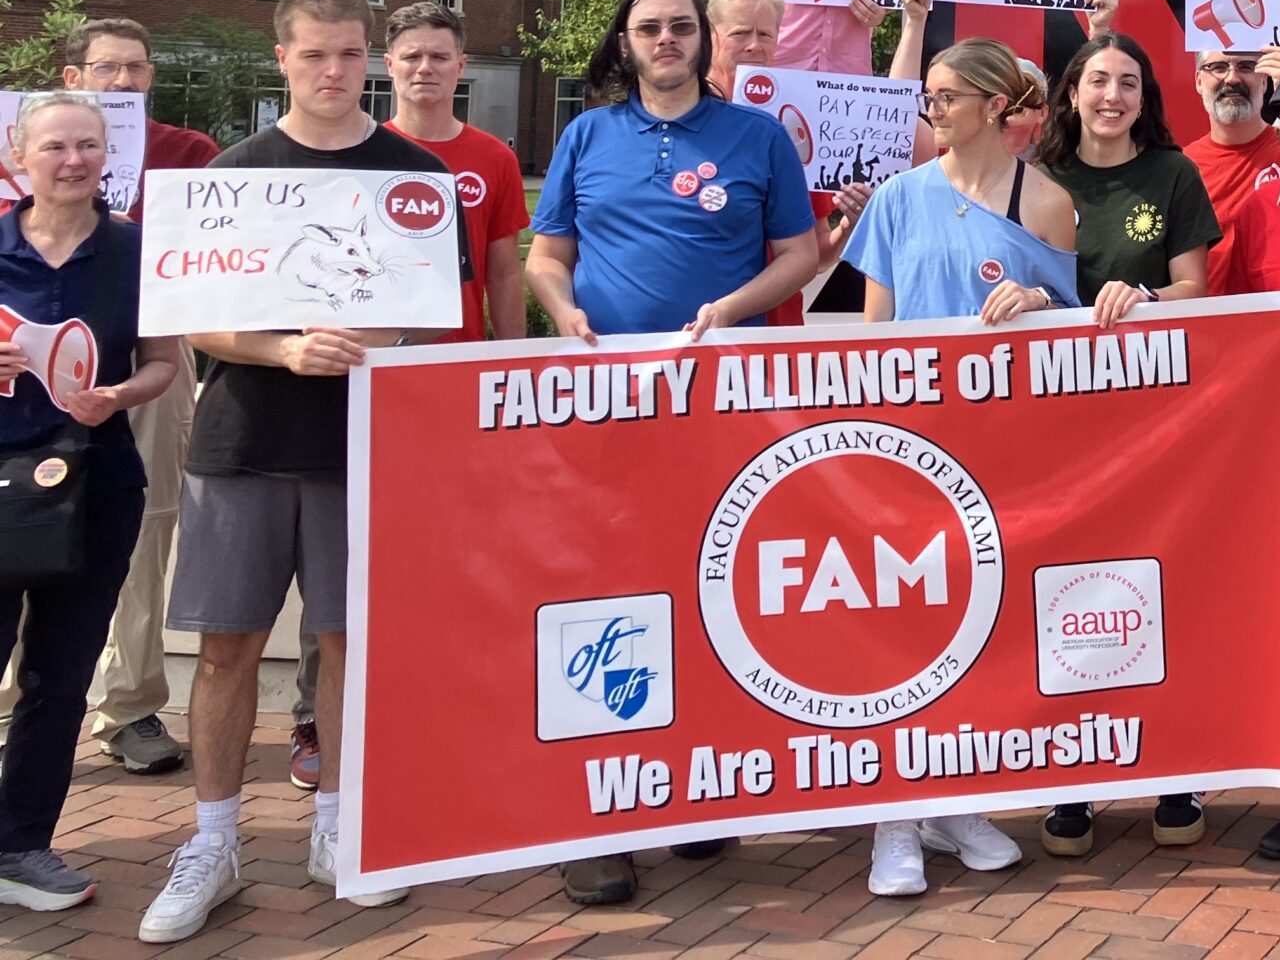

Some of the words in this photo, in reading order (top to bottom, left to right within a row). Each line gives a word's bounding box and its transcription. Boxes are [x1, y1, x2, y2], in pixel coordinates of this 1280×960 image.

[747, 83, 773, 96] FAM
[817, 80, 844, 91] What
[847, 83, 859, 92] do
[880, 87, 913, 96] want?!
[819, 95, 856, 117] PAY
[865, 104, 916, 125] THAT
[819, 121, 914, 148] RESPECTS
[819, 146, 855, 160] OUR
[869, 144, 913, 161] LABOR
[187, 181, 248, 209] PAY
[266, 182, 308, 208] US
[458, 183, 481, 196] FAM
[392, 198, 440, 216] FAM
[1133, 203, 1157, 214] THE
[200, 216, 239, 230] OR
[1126, 215, 1163, 242] LUMINEERS
[156, 248, 272, 280] CHAOS
[983, 266, 1000, 277] FAM
[479, 358, 698, 430] FACULTY
[714, 348, 941, 411] ALLIANCE
[958, 343, 1012, 401] of
[1028, 329, 1188, 396] MIAMI
[706, 465, 772, 583] FACULTY
[774, 431, 912, 473] ALLIANCE
[918, 452, 953, 480] OF
[948, 478, 996, 567] MIAMI
[759, 531, 948, 617] FAM
[1048, 597, 1059, 612] 100
[1060, 576, 1085, 595] YEARS
[1106, 572, 1148, 607] DEFENDING
[1062, 609, 1142, 646] aaup
[1052, 649, 1099, 680] ACADEMIC
[1107, 643, 1147, 678] FREEDOM
[608, 668, 656, 715] aft
[746, 668, 843, 718] AAUP-AFT
[862, 680, 932, 718] LOCAL
[930, 655, 960, 686] 375
[586, 754, 670, 813] We
[687, 747, 772, 801] Are
[788, 734, 882, 789] The
[894, 714, 1140, 781] University
